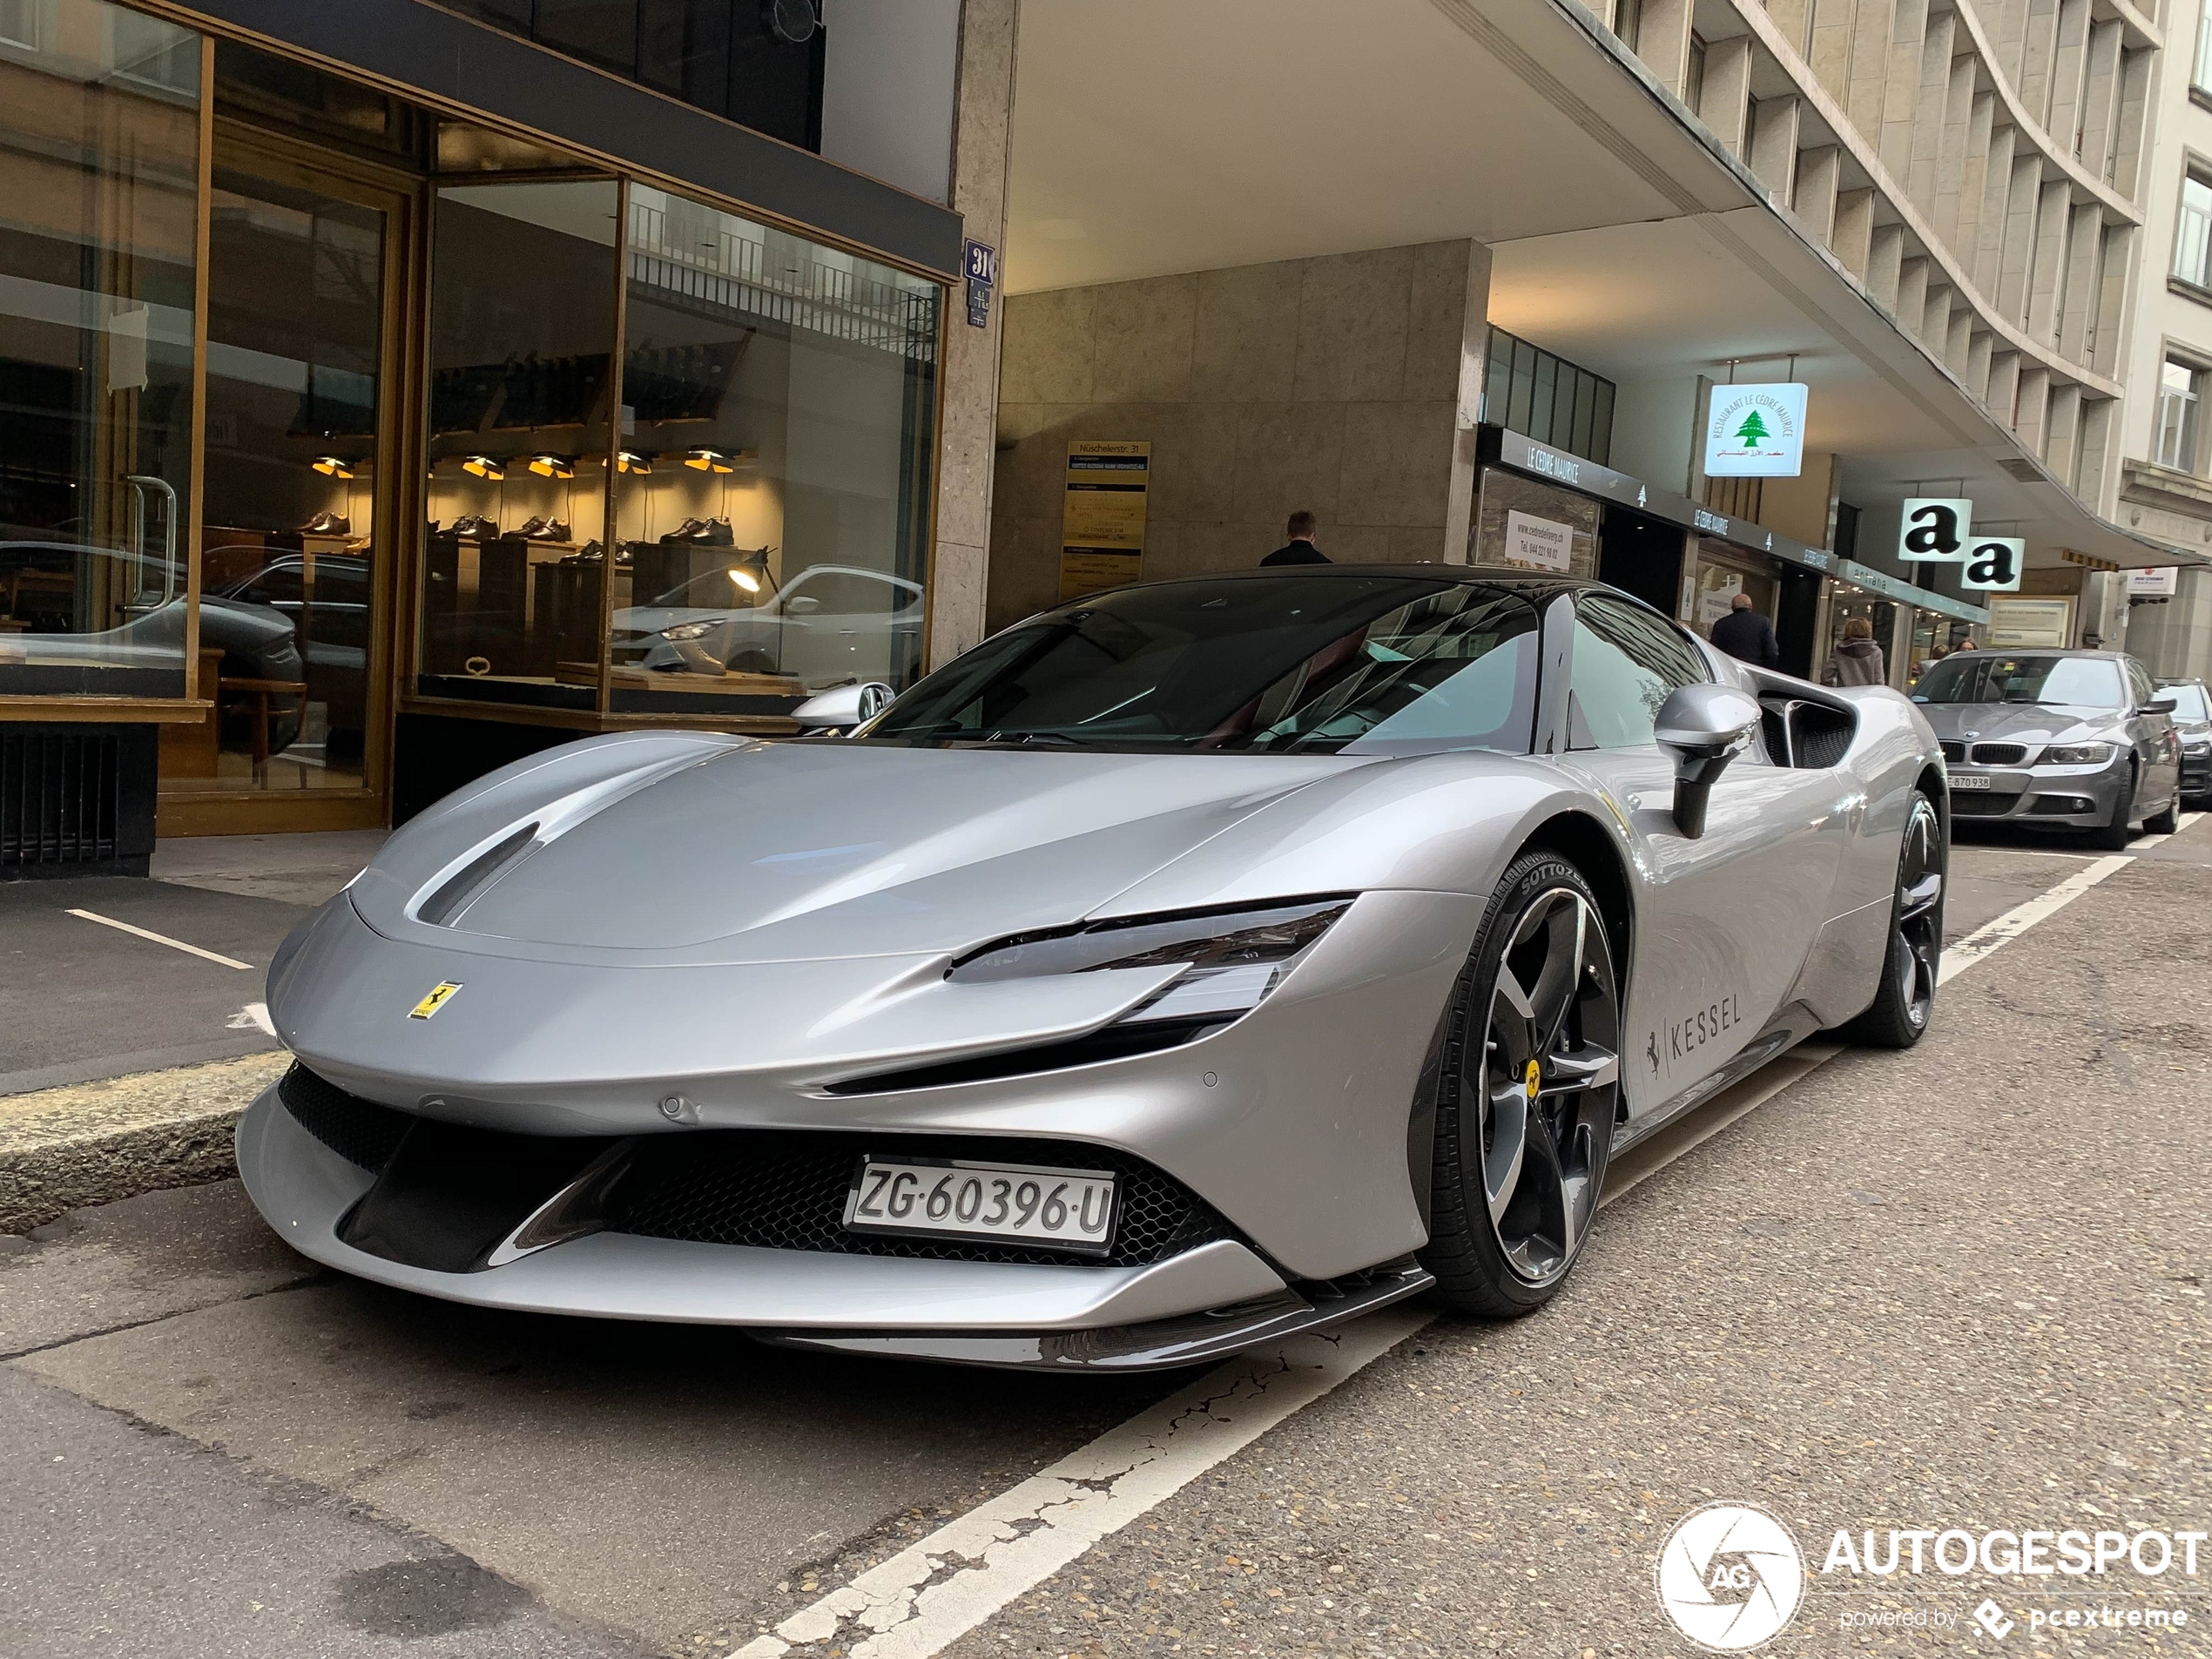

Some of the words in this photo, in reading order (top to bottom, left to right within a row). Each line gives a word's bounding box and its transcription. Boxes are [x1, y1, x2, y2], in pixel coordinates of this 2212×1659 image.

[972, 247, 988, 277] 31
[1713, 397, 1744, 439] RESTAURANT
[1744, 395, 1754, 405] LE
[1775, 405, 1793, 438] MAURICE
[1079, 444, 1129, 453] Nüschelerstr.
[1527, 446, 1535, 469] LE
[1535, 445, 1554, 475] CÈDRE
[1553, 456, 1580, 484] MAURICE
[1518, 524, 1564, 544] www.cedredelivery.ch
[1905, 505, 1961, 555] a
[1529, 543, 1538, 555] 044
[1967, 543, 2015, 584] a
[1973, 778, 1989, 787] 938
[1671, 994, 1741, 1060] KESSEL
